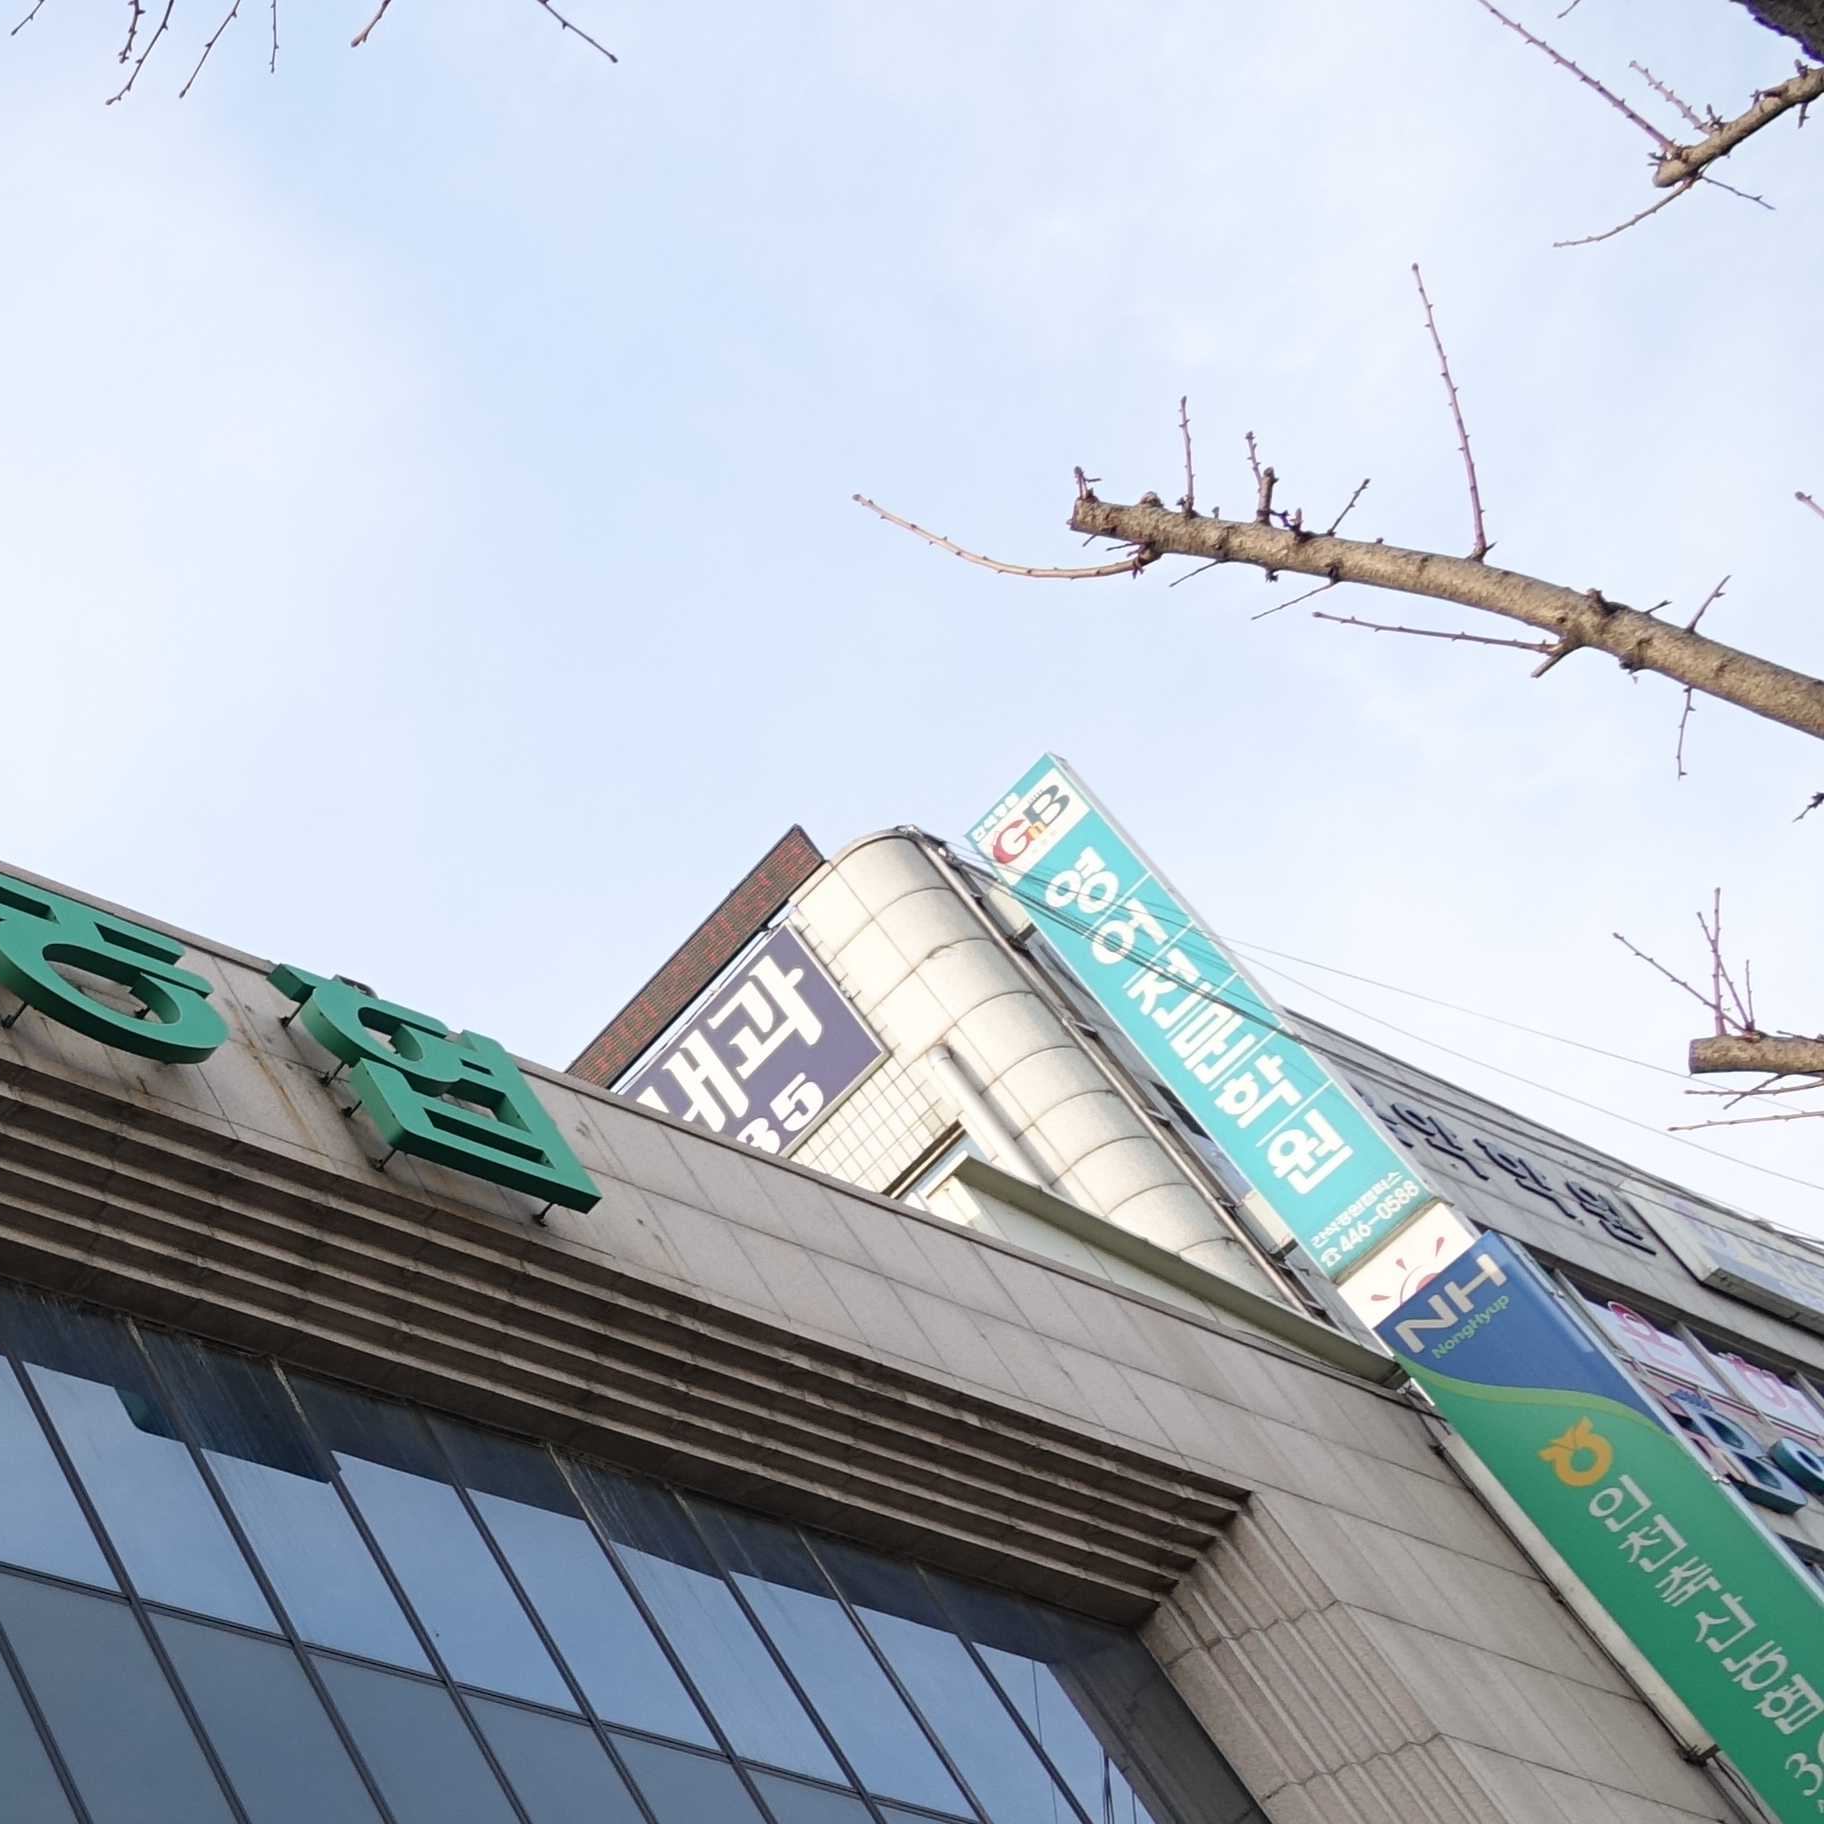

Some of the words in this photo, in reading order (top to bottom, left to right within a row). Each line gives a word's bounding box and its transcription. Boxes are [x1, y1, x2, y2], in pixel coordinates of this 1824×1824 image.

[1045, 846, 1352, 1195] 영어전문학원
[1339, 1180, 1420, 1252] 446-0588
[1394, 1253, 1507, 1353] NH
[1431, 1295, 1510, 1359] NongHyup
[1589, 1474, 1824, 1734] 인천축산농협
